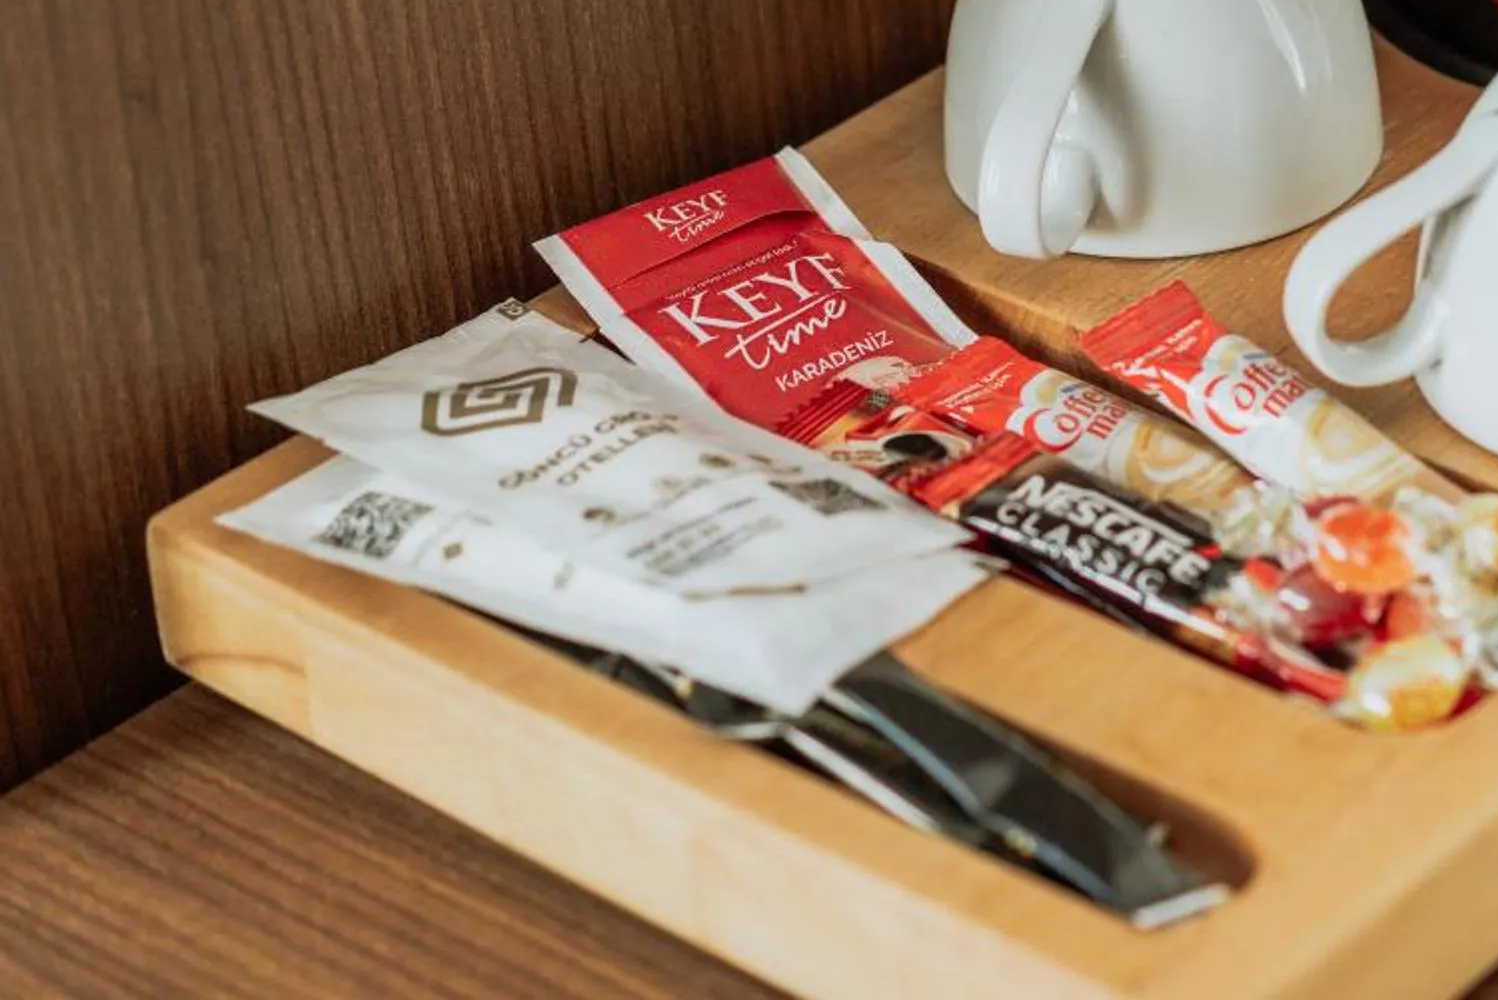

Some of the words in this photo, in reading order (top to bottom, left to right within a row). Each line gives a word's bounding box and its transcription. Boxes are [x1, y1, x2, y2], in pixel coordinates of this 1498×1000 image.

[643, 190, 728, 232] KEYF
[667, 210, 725, 245] time
[660, 251, 853, 347] KEYF
[724, 293, 848, 370] time
[775, 330, 896, 393] KARADENİZ
[996, 501, 1167, 595] CLASSIC
